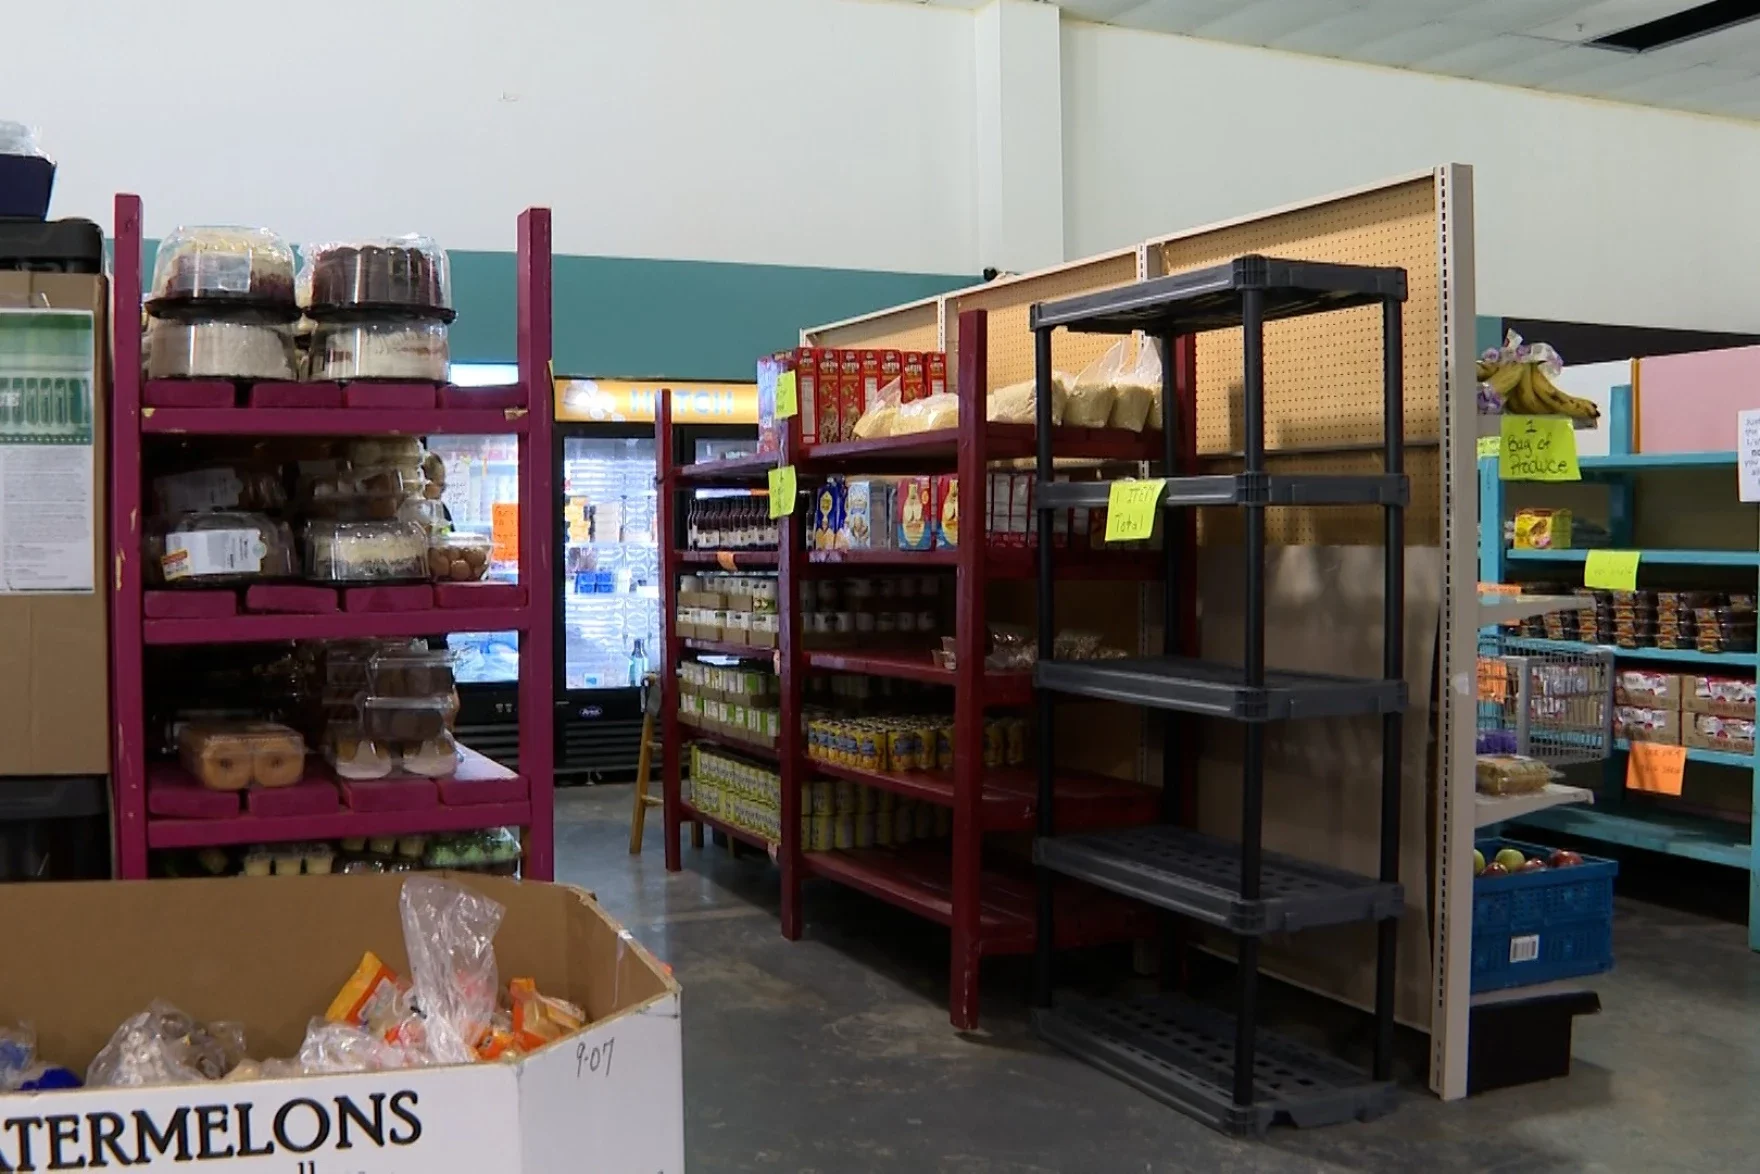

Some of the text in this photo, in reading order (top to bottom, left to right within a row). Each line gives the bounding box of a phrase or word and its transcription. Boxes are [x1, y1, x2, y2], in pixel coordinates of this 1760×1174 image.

[630, 389, 734, 415] HTCH
[1508, 434, 1532, 458] Bag
[1509, 454, 1568, 475] Produce
[1114, 512, 1144, 532] Total
[0, 1089, 423, 1172] TERMELONS
